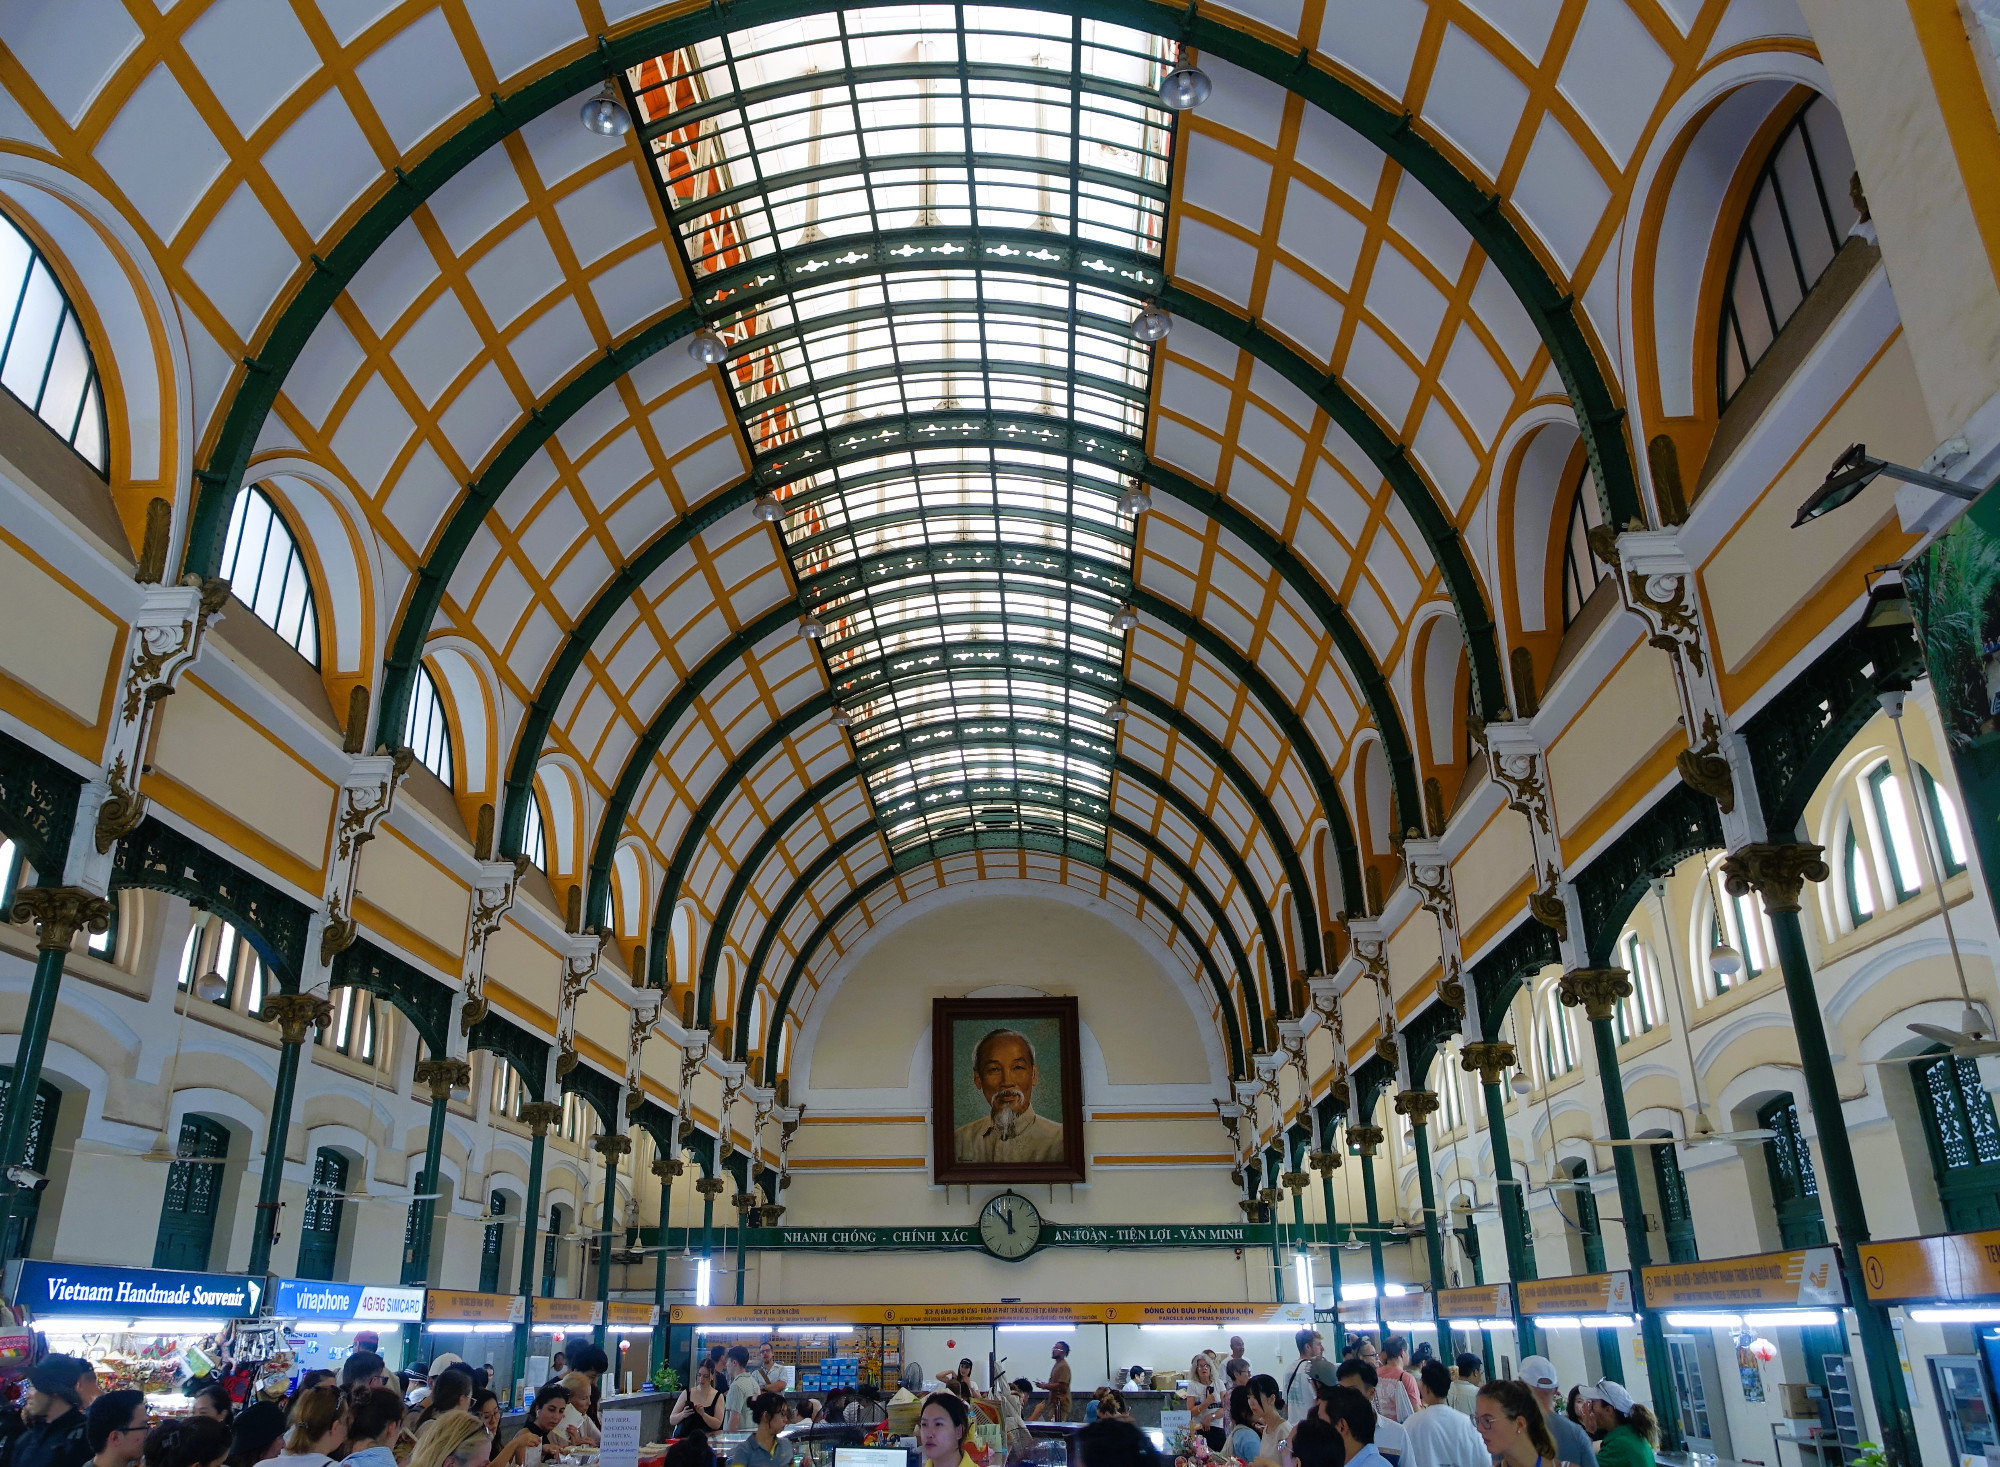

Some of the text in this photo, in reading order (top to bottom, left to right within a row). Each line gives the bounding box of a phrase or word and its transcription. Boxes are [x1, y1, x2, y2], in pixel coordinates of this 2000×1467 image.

[783, 1232, 828, 1243] NHANH
[832, 1228, 877, 1243] CHÓNG
[892, 1228, 936, 1242] CHÍNH
[941, 1228, 968, 1242] XÁC
[1055, 1230, 1071, 1241] AN
[1073, 1226, 1107, 1241] TOÀN
[1116, 1226, 1147, 1243] TIỆN
[1149, 1228, 1171, 1243] LỢI
[1179, 1226, 1206, 1240] VĂN
[1209, 1228, 1243, 1240] MINH
[47, 1277, 245, 1307] Vietnam Handmade Souvenir
[296, 1287, 350, 1313] vinaphone
[362, 1296, 386, 1312] 4G/5G
[1144, 1306, 1165, 1314] ĐÓNG
[1166, 1306, 1179, 1314] GÓI
[1236, 1306, 1254, 1316] KIỆN
